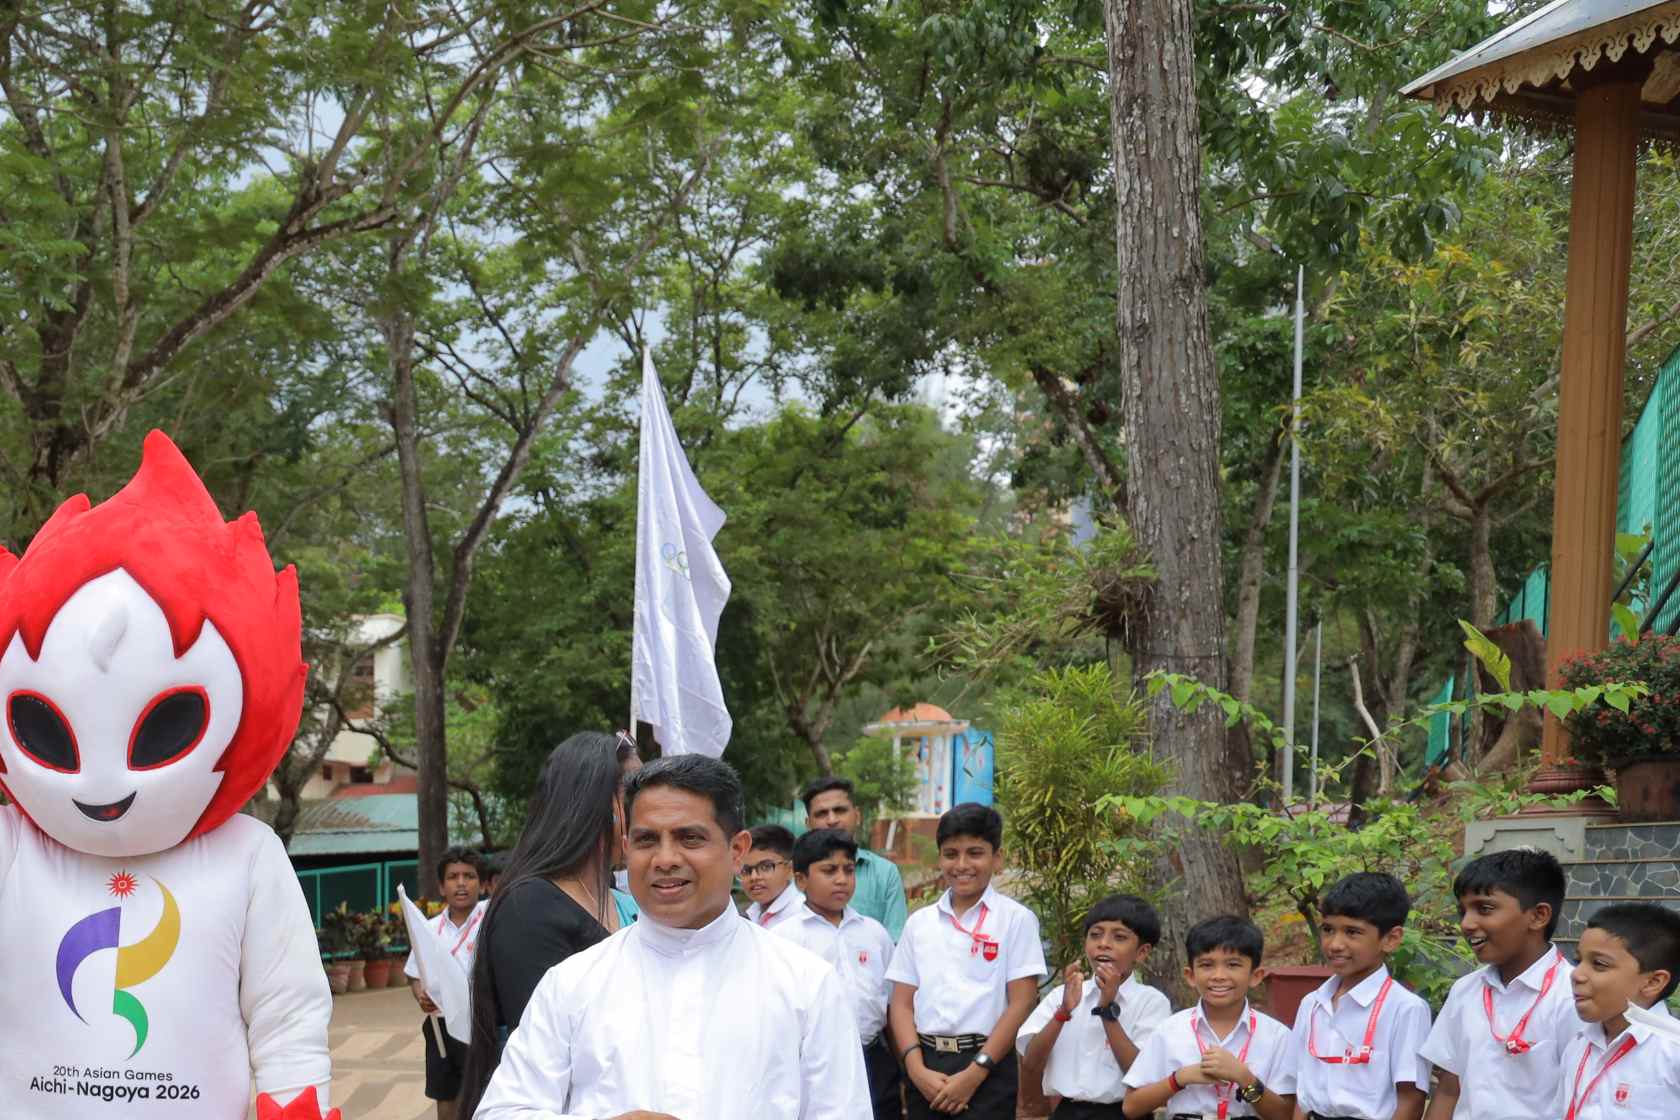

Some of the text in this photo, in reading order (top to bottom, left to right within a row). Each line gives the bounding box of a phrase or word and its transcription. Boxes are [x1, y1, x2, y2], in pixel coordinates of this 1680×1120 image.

[53, 1065, 174, 1082] 20th Asian Games
[30, 1076, 201, 1103] Aichi-Nagoya 2026
